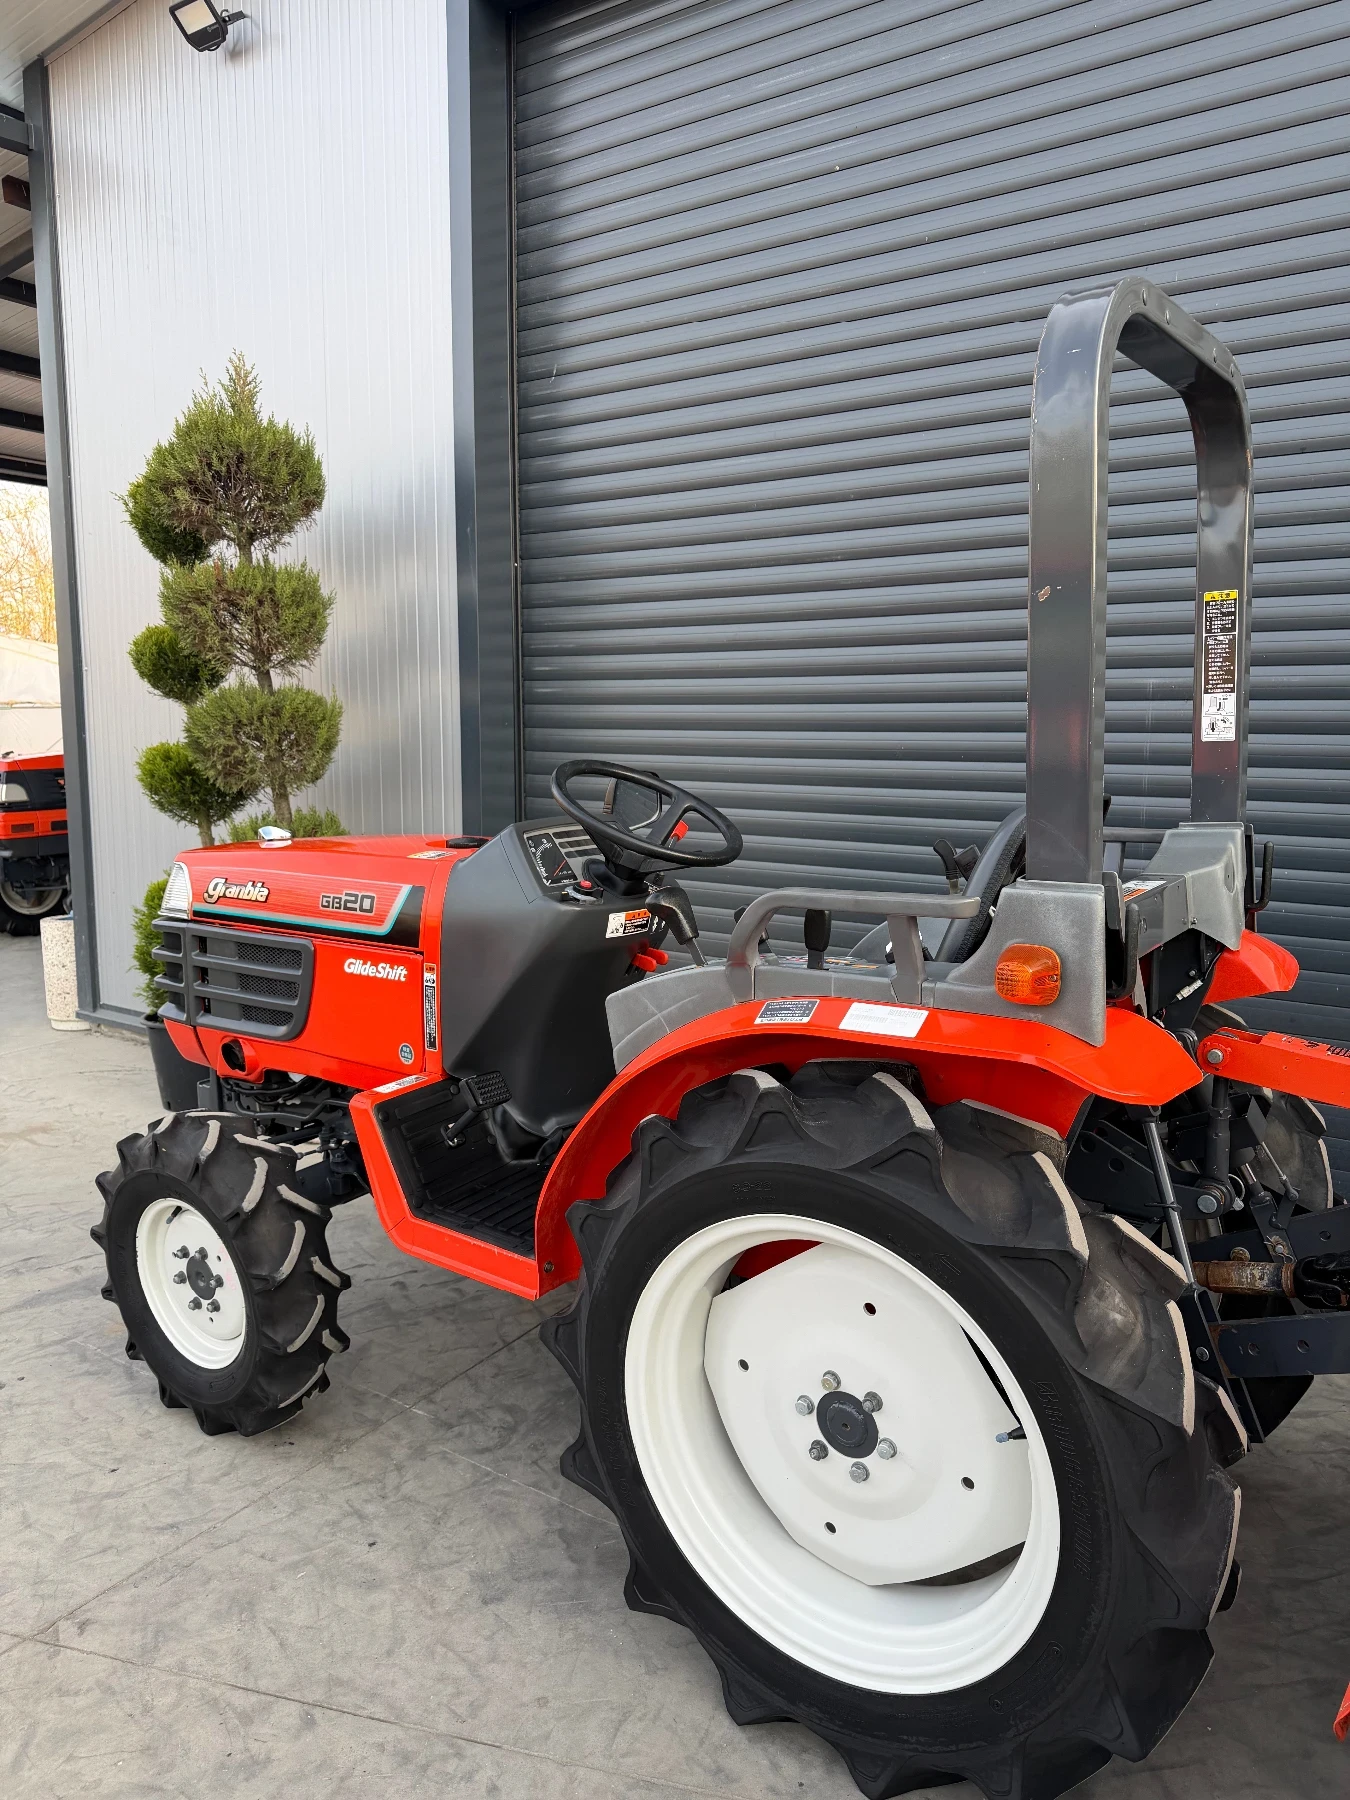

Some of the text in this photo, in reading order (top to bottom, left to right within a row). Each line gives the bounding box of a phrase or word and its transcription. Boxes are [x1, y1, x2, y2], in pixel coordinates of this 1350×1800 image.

[321, 892, 375, 914] GB20
[344, 958, 408, 982] GlideShift
[1029, 1380, 1092, 1576] BRIDGESTONE
